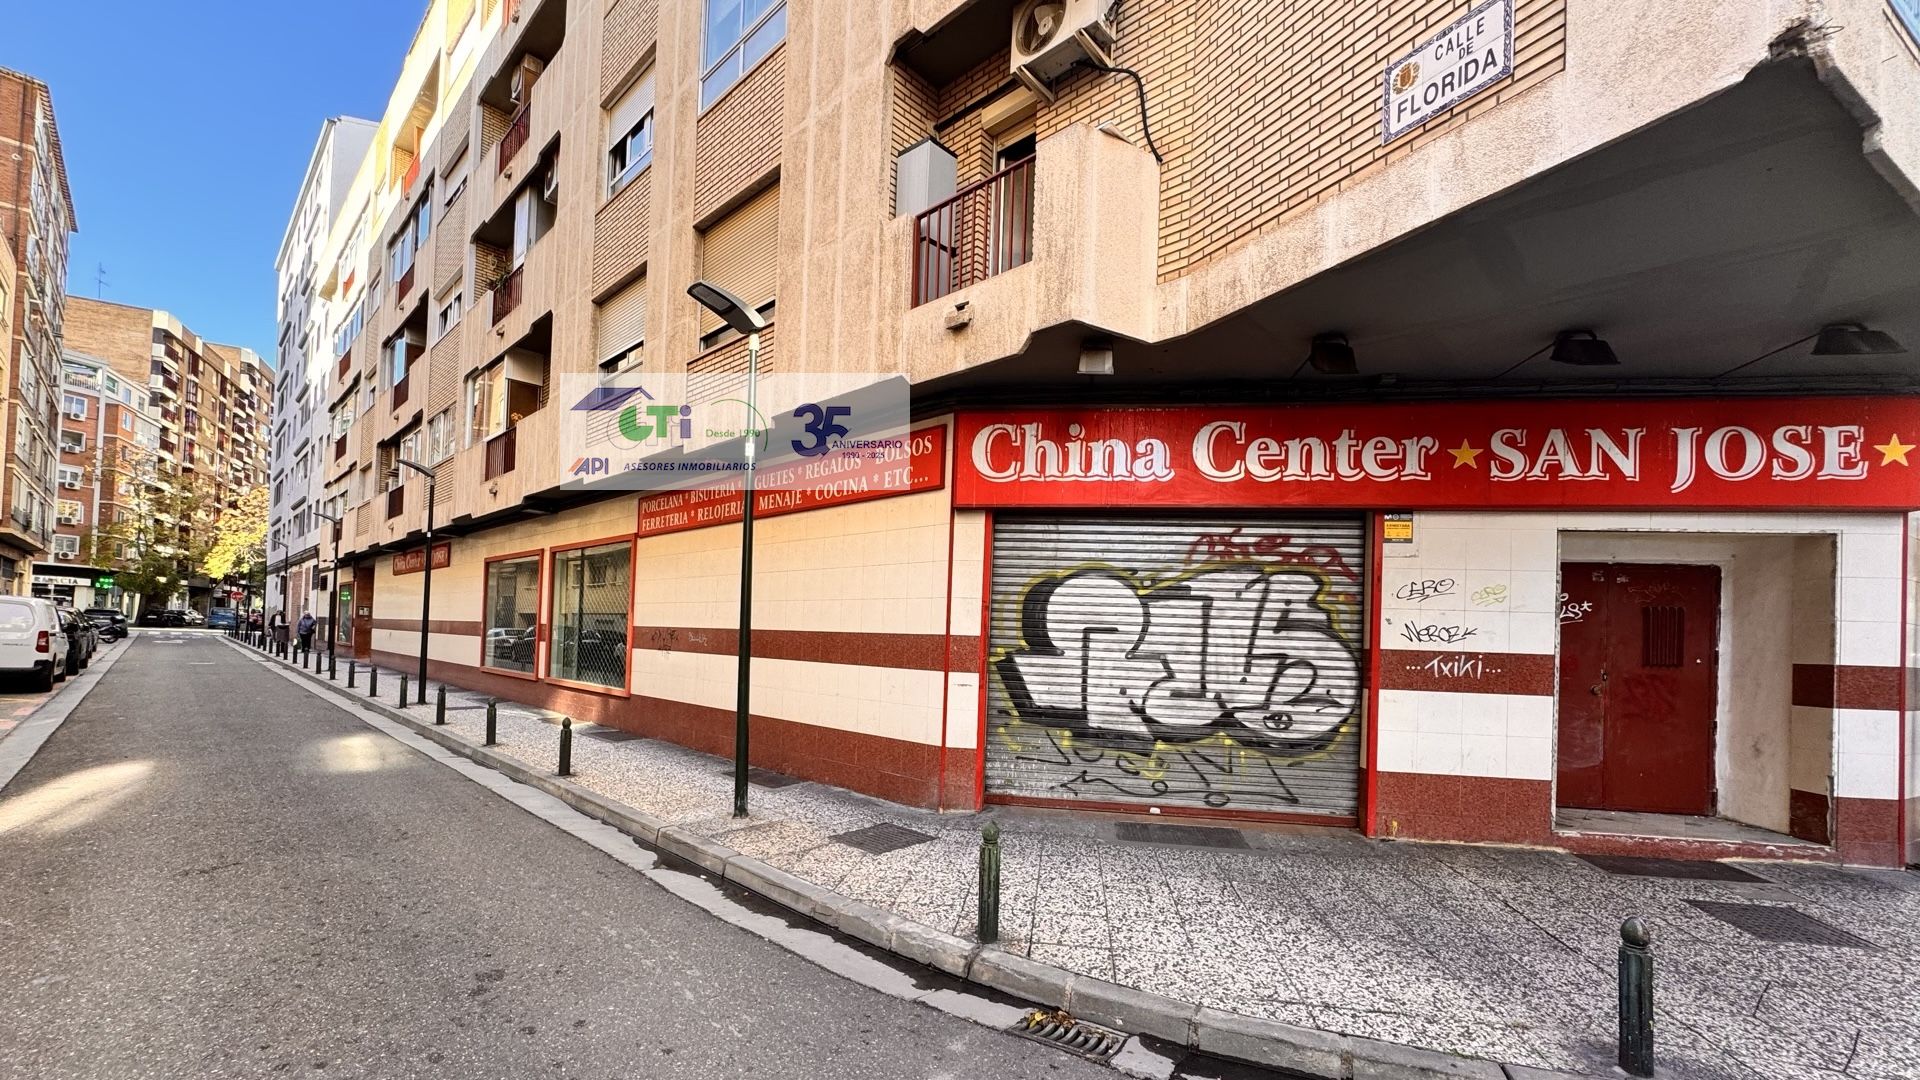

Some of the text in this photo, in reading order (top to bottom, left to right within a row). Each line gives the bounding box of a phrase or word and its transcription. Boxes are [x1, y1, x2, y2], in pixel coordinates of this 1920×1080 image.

[1435, 16, 1485, 61] CALLE
[1459, 41, 1474, 60] DE
[1397, 47, 1498, 123] FLORIDA
[641, 494, 684, 514] PORCELANA
[690, 481, 736, 504] BISUTERIA
[805, 456, 862, 480] REGALOS
[875, 435, 933, 465] BOLSOS
[971, 420, 1869, 494] China Center SAN JOSE
[641, 511, 689, 532] FERRETERIA
[758, 488, 803, 511] MENAJE
[815, 473, 869, 501] COCINA
[883, 466, 929, 489] ETC...
